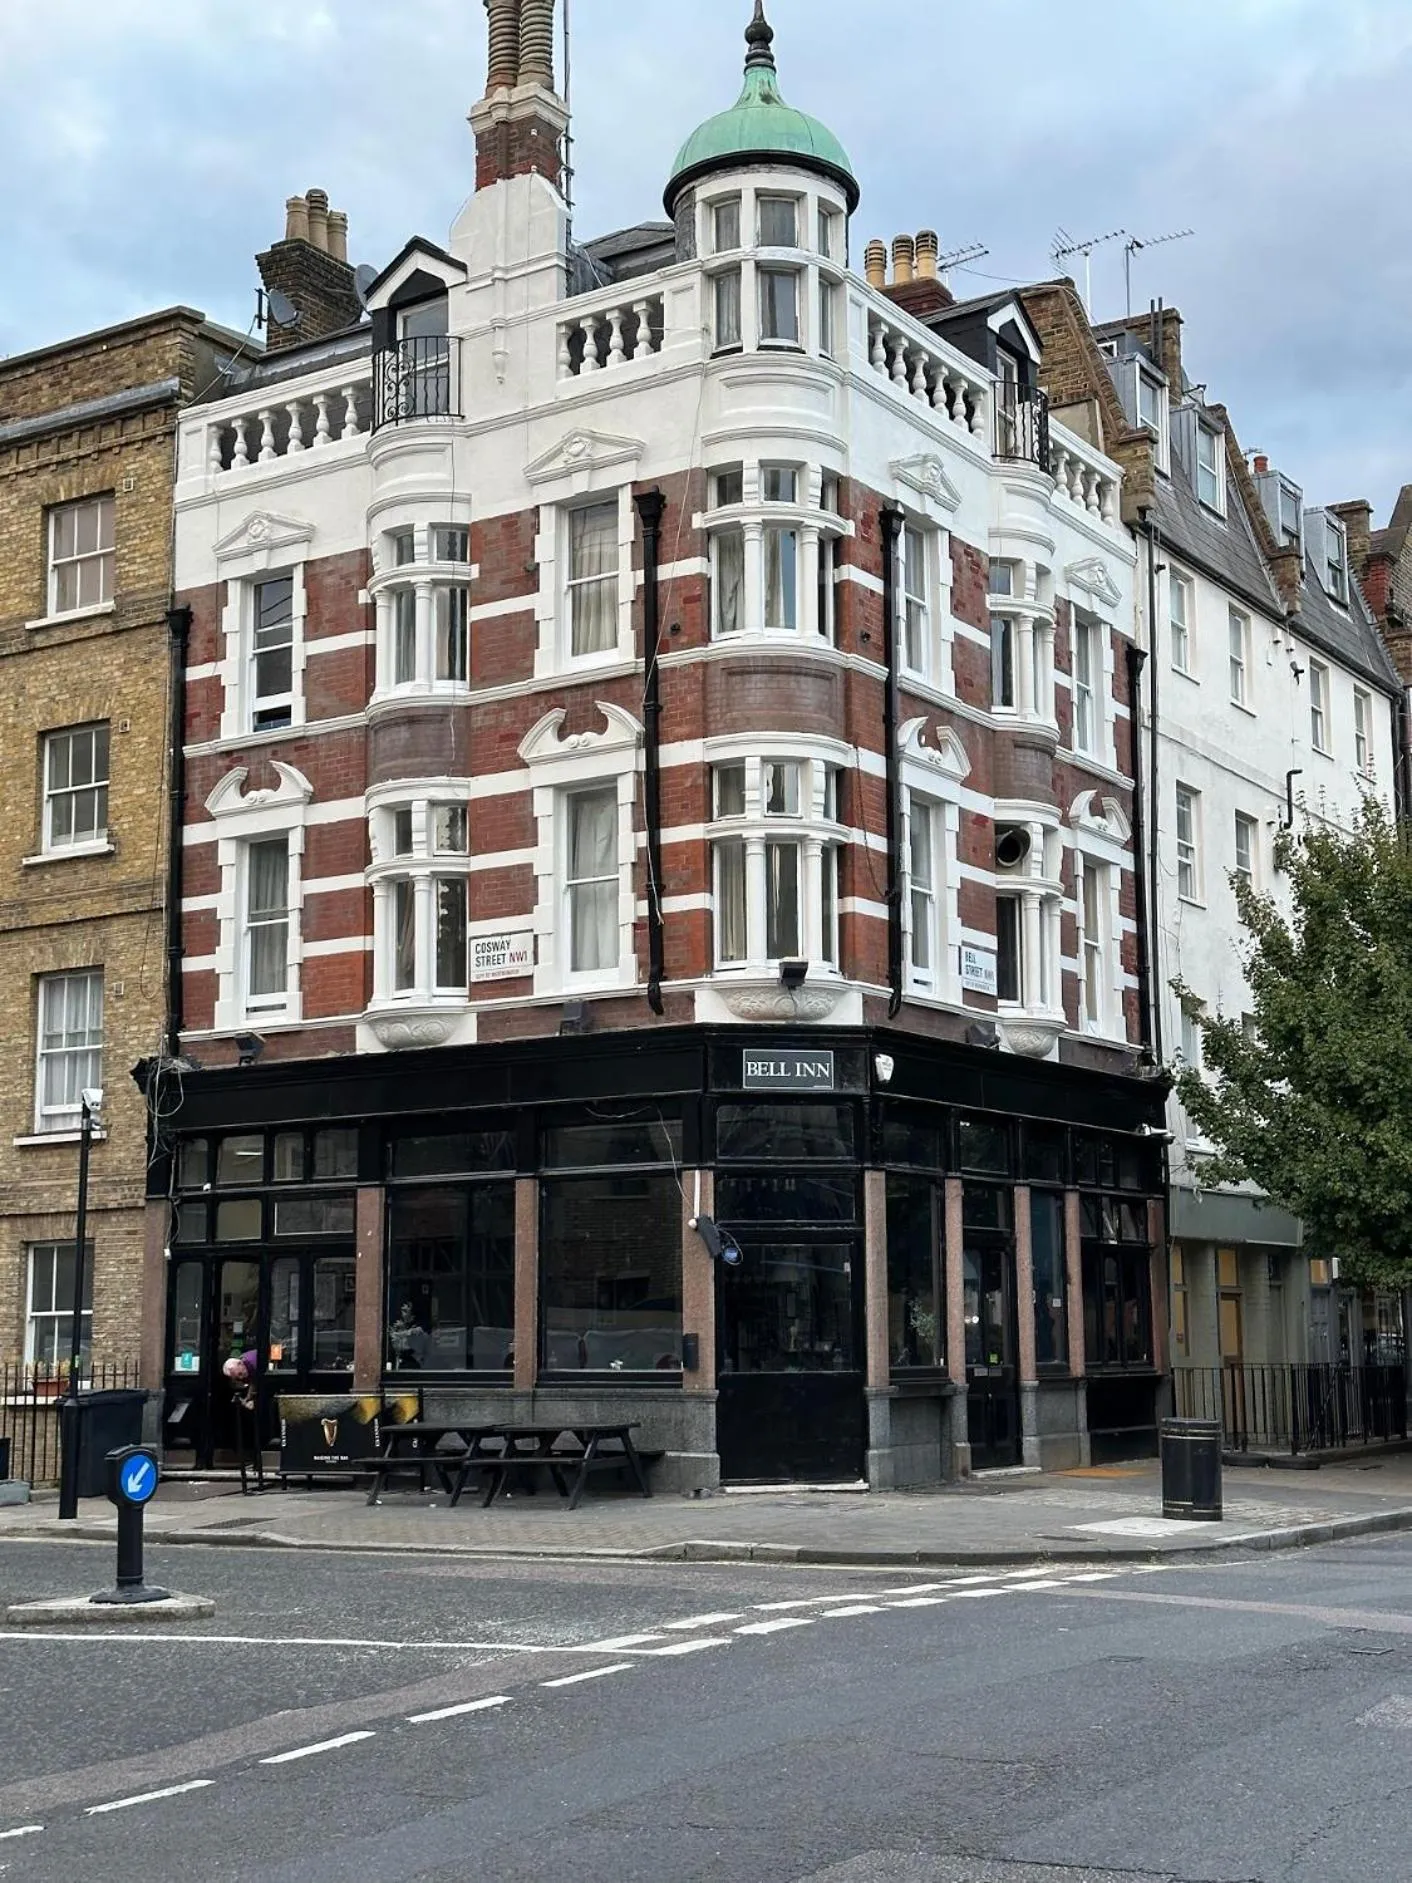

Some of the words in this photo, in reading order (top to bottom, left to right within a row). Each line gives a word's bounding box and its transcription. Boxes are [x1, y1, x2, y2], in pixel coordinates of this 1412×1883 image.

[475, 939, 511, 954] COSWAY
[475, 953, 506, 967] STREET
[509, 950, 528, 963] NW1
[965, 964, 983, 977] STREET
[746, 1061, 791, 1077] BELL
[795, 1062, 830, 1078] INN
